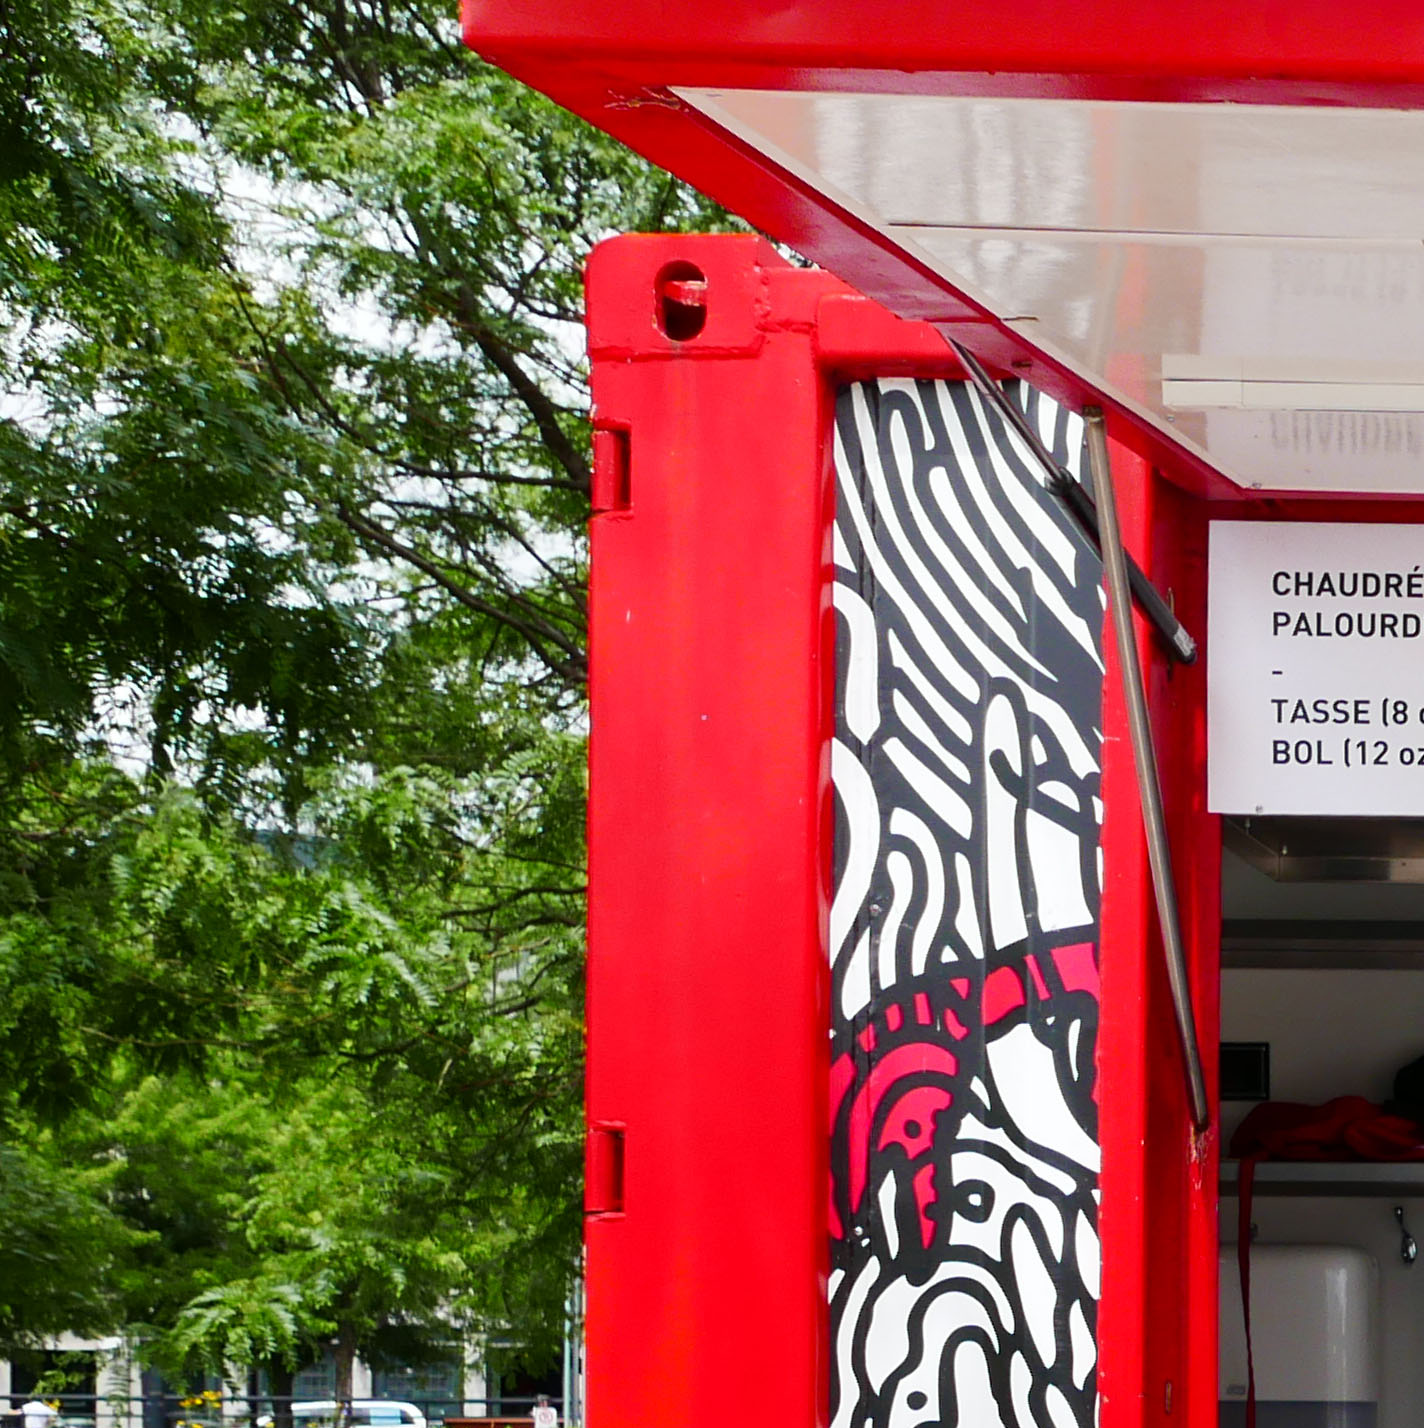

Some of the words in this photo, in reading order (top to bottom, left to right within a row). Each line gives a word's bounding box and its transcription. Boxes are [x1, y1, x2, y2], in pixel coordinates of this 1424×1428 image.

[1270, 698, 1371, 725] TASSE
[1382, 697, 1408, 727] (8
[1272, 739, 1333, 765] BOL
[1344, 737, 1389, 768] (12
